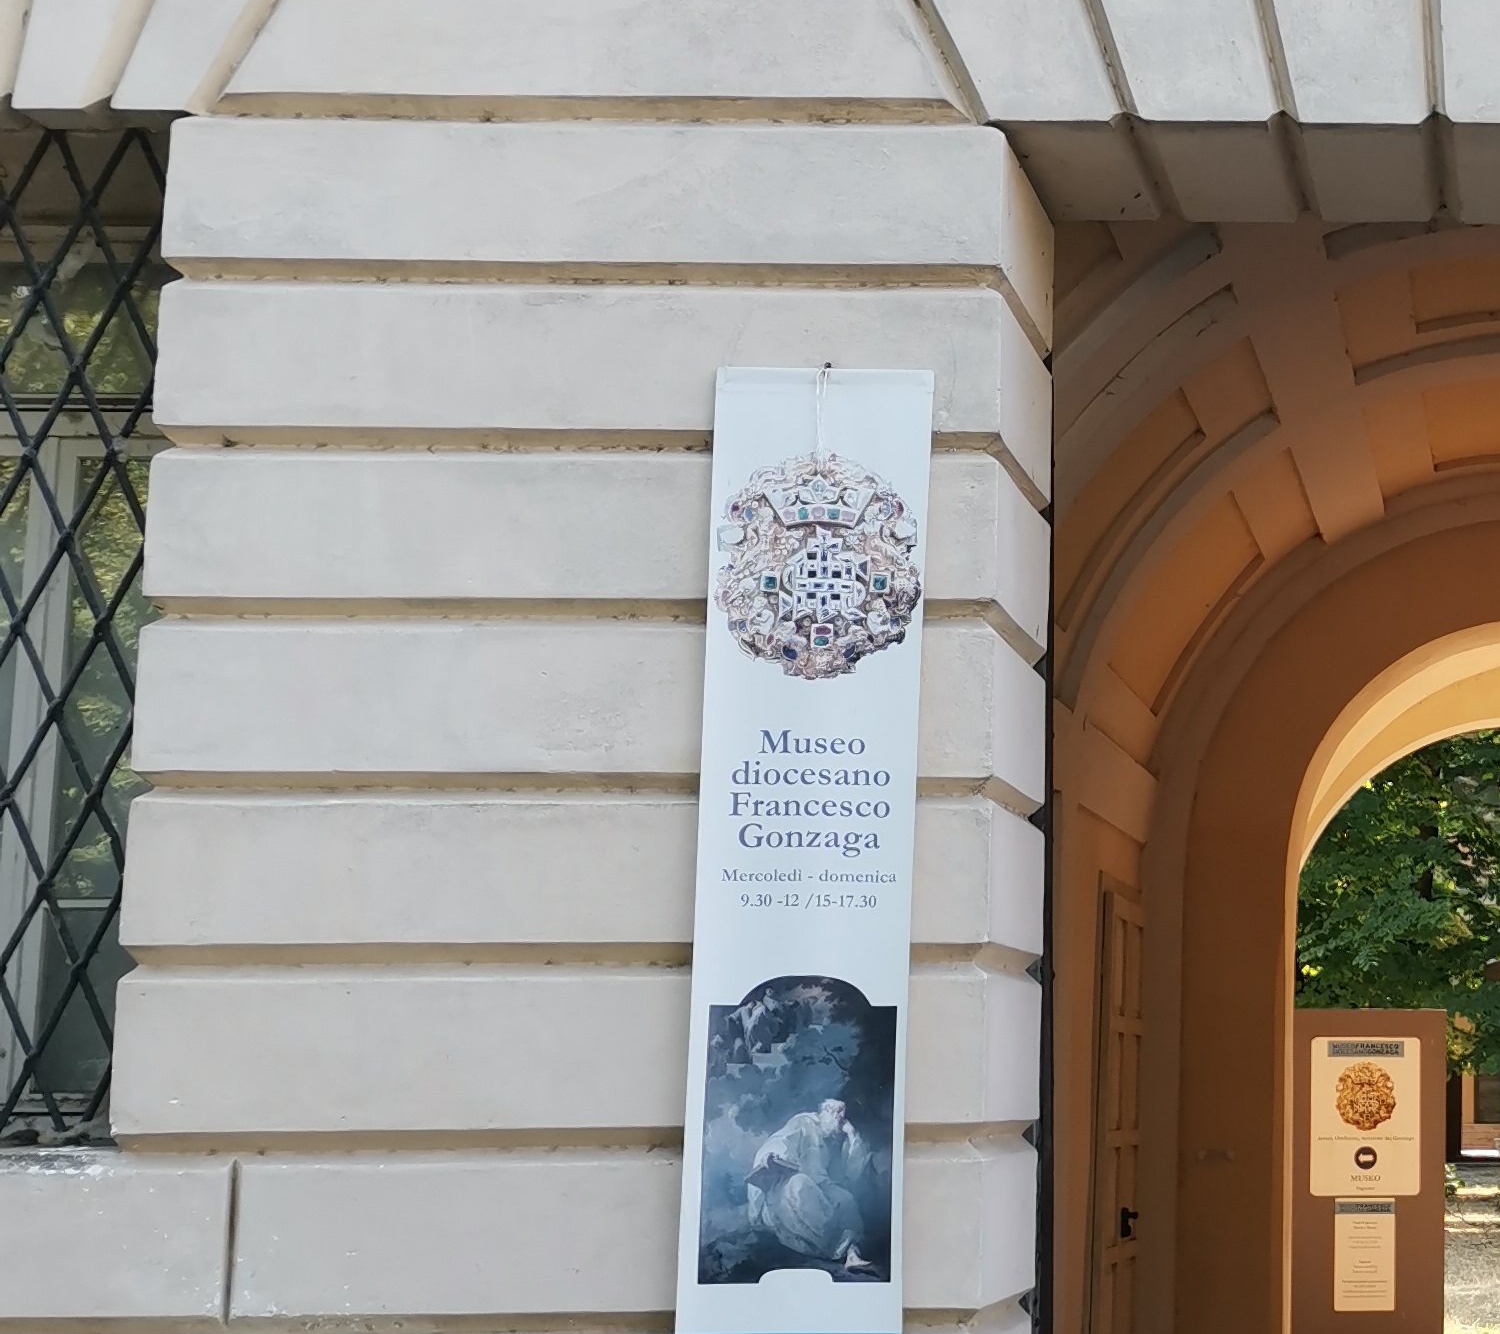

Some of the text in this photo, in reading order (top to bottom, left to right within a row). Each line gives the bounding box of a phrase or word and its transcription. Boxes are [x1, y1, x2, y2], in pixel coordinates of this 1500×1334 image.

[758, 729, 866, 755] Museo
[731, 760, 891, 787] diocesano
[728, 791, 891, 819] Francesco
[738, 822, 881, 858] Gonzaga
[720, 868, 803, 883] Mercoledì
[818, 869, 897, 884] domenica
[740, 893, 773, 908] 9.30
[1350, 1174, 1381, 1182] MUSEO
